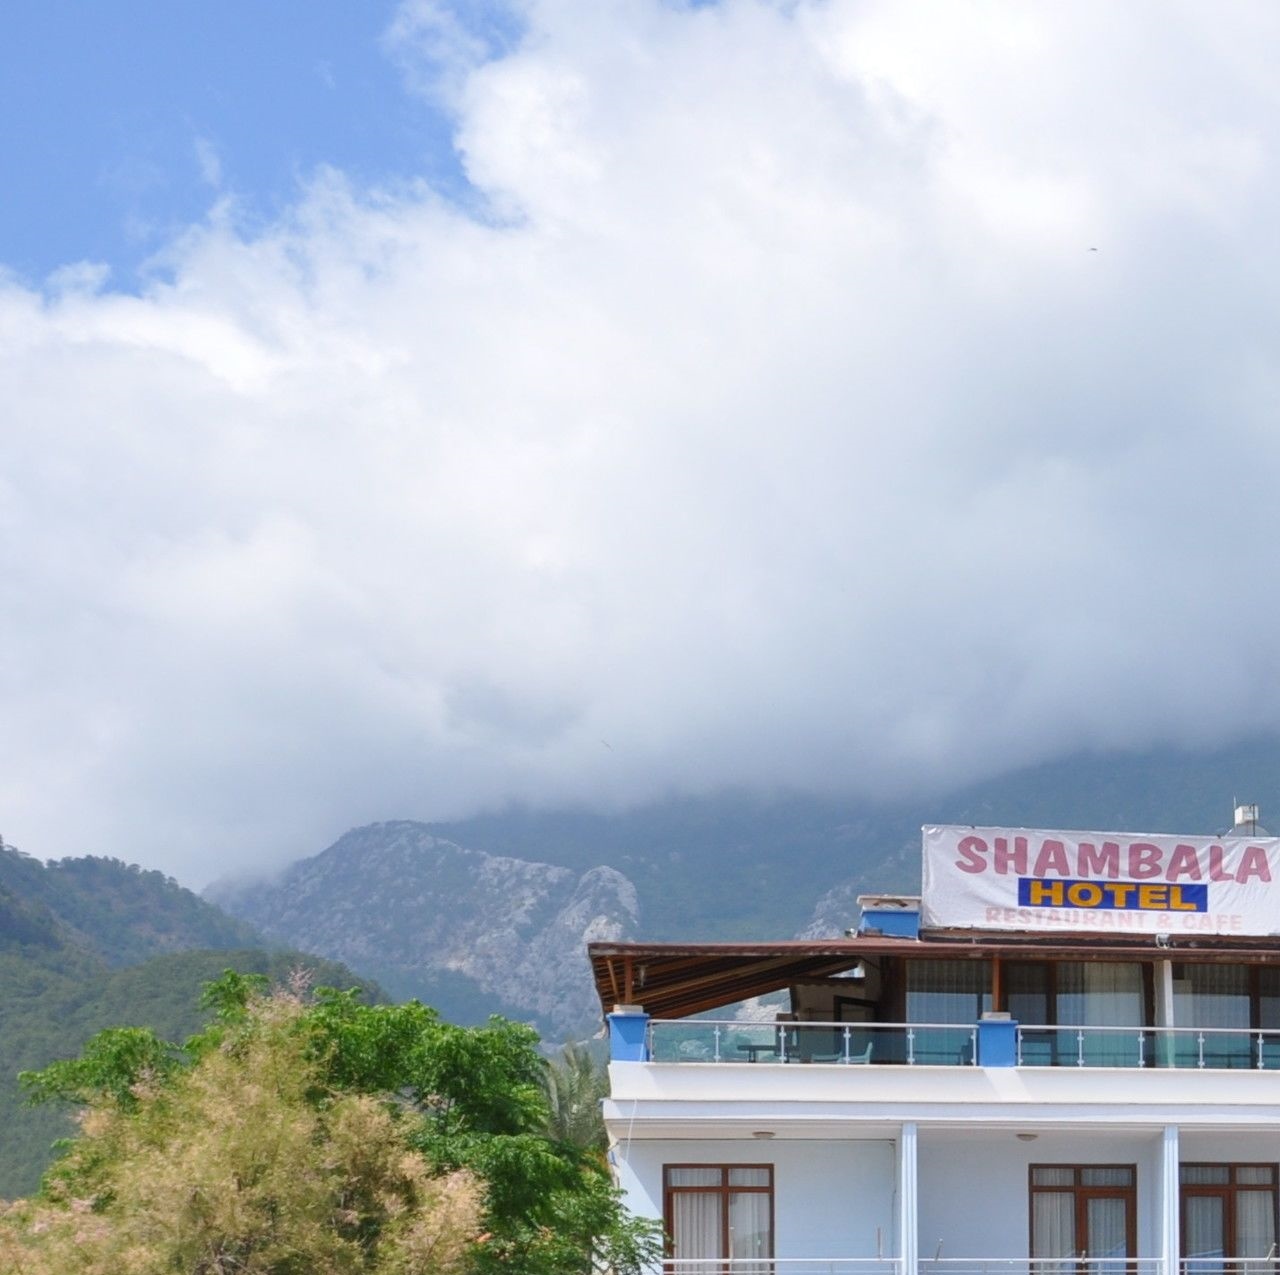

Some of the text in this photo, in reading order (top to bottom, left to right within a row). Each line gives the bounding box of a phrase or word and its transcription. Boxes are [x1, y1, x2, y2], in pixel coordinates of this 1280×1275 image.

[955, 835, 1273, 884] SHAMBALA
[1029, 881, 1198, 911] HOTEL
[985, 906, 1243, 931] RESTAURANT & CAFE
